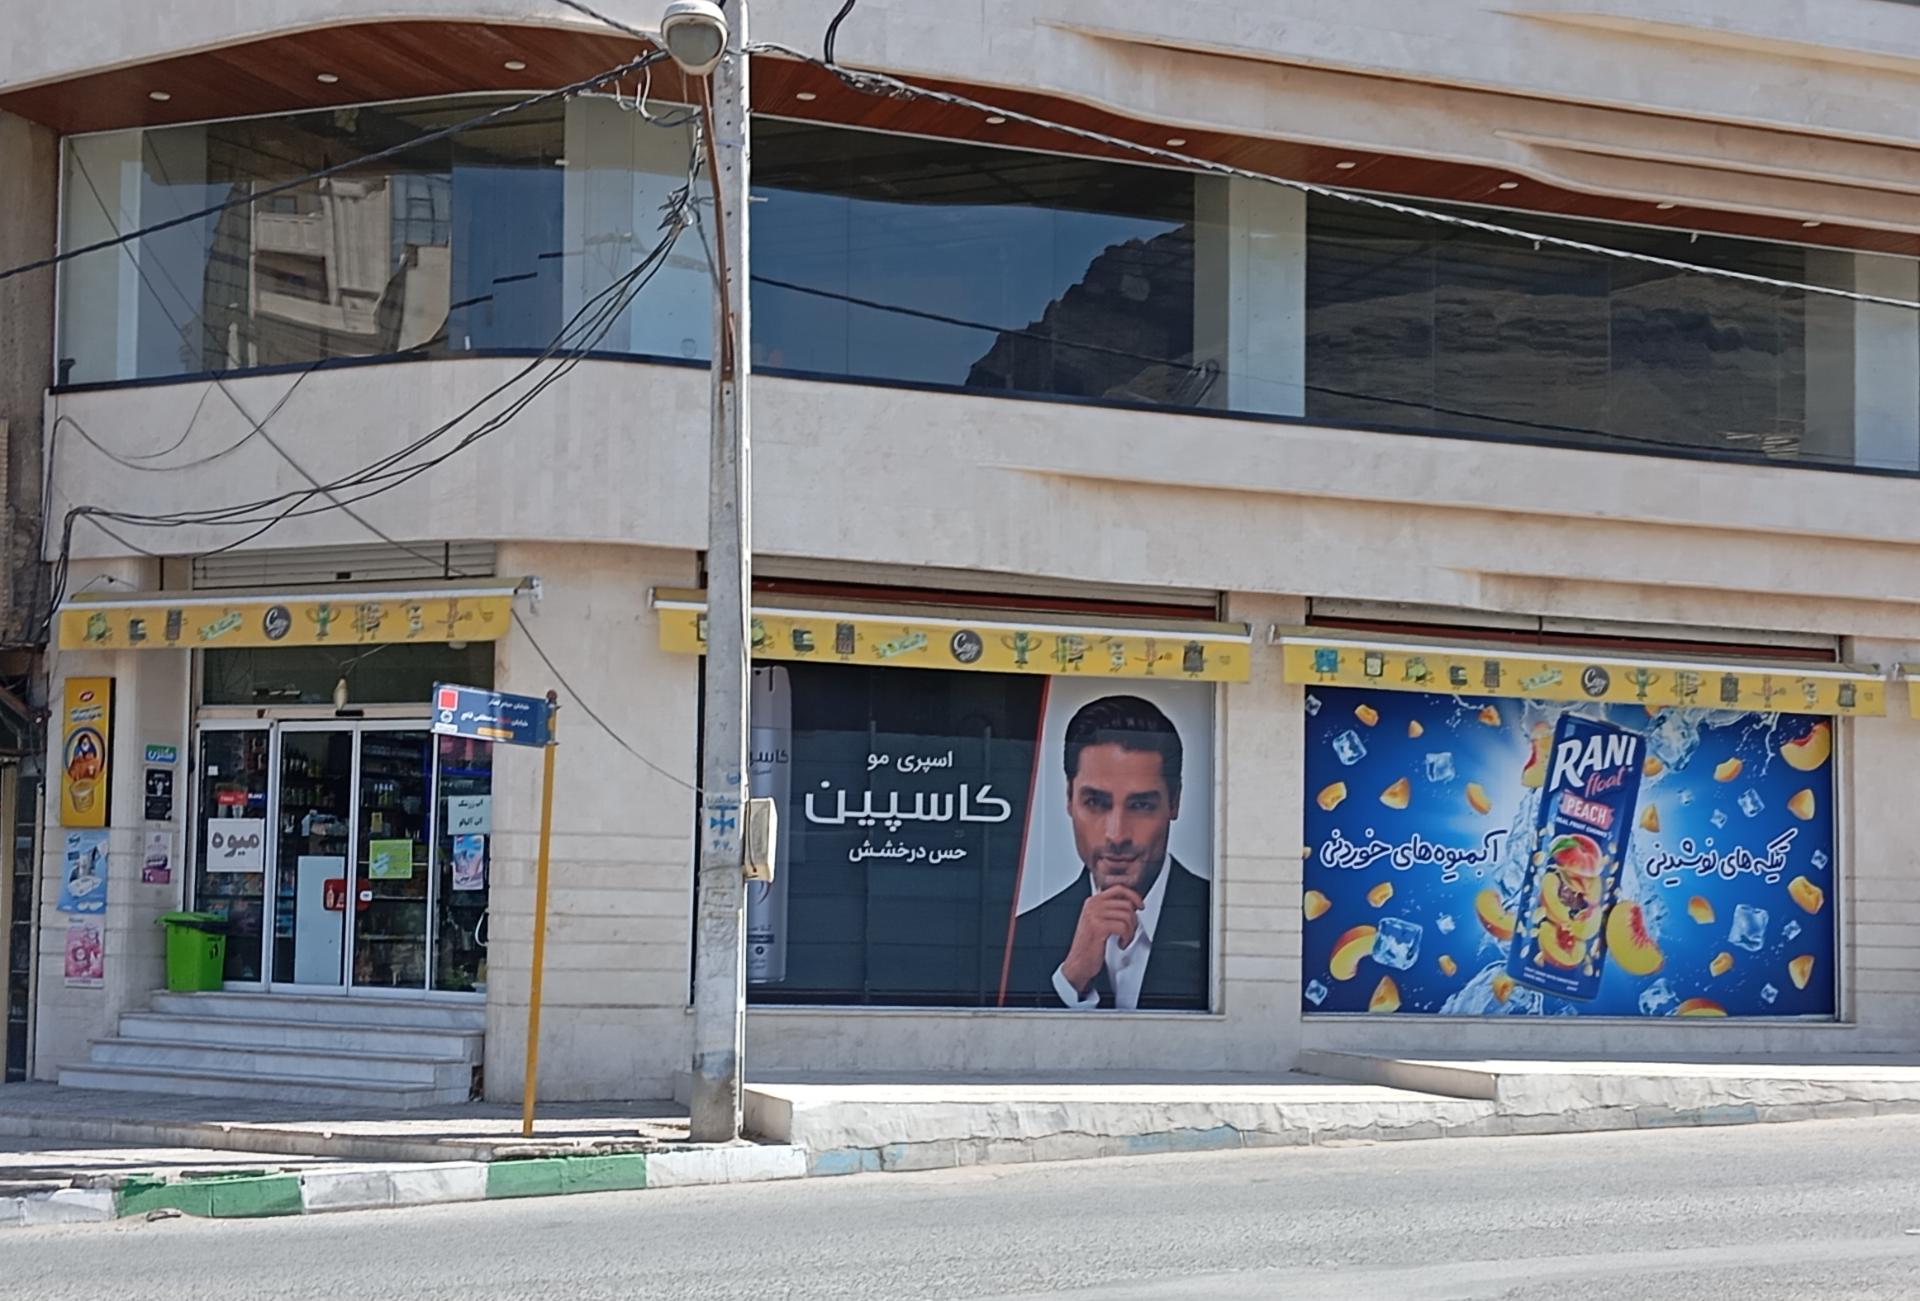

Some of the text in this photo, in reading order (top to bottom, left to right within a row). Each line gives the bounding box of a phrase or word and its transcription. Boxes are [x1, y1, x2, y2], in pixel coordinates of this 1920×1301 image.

[867, 750, 953, 773] اسپری مو
[1548, 733, 1638, 793] RANI
[1584, 765, 1626, 799] float
[804, 780, 1012, 833] کاسپین
[1566, 799, 1609, 826] PEACH
[211, 831, 260, 858] میوه
[849, 840, 967, 864] حس درخشش
[1320, 828, 1392, 868] خوردنی
[1645, 837, 1718, 887] نوشیدنی
